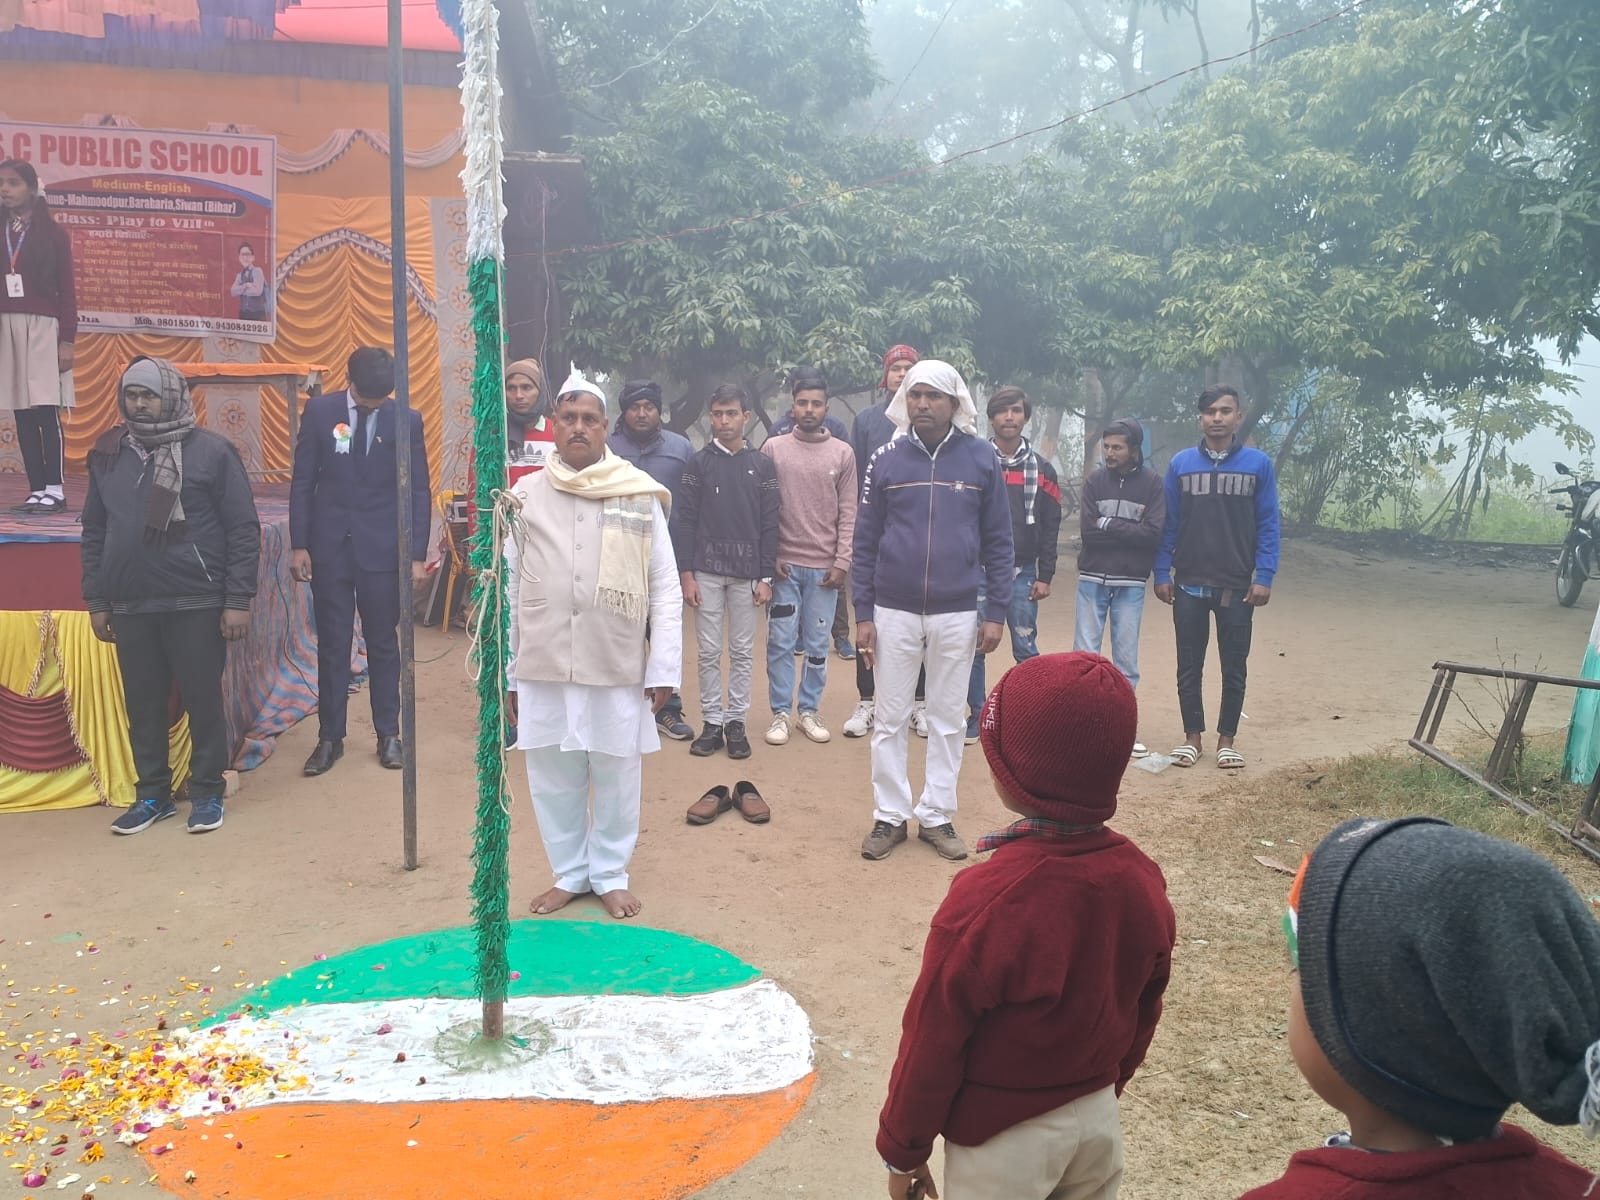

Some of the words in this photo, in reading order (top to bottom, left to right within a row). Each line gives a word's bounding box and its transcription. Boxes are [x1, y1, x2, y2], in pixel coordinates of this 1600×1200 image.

[0, 132, 32, 161] .C
[39, 134, 142, 169] PUBLIC
[150, 139, 263, 177] SCHOOL
[92, 178, 192, 194] Medium-English
[204, 200, 237, 214] (Bihar)
[54, 212, 100, 226] Class:
[106, 214, 145, 228] Play
[150, 216, 165, 228] to
[705, 542, 753, 557] ACTIVE
